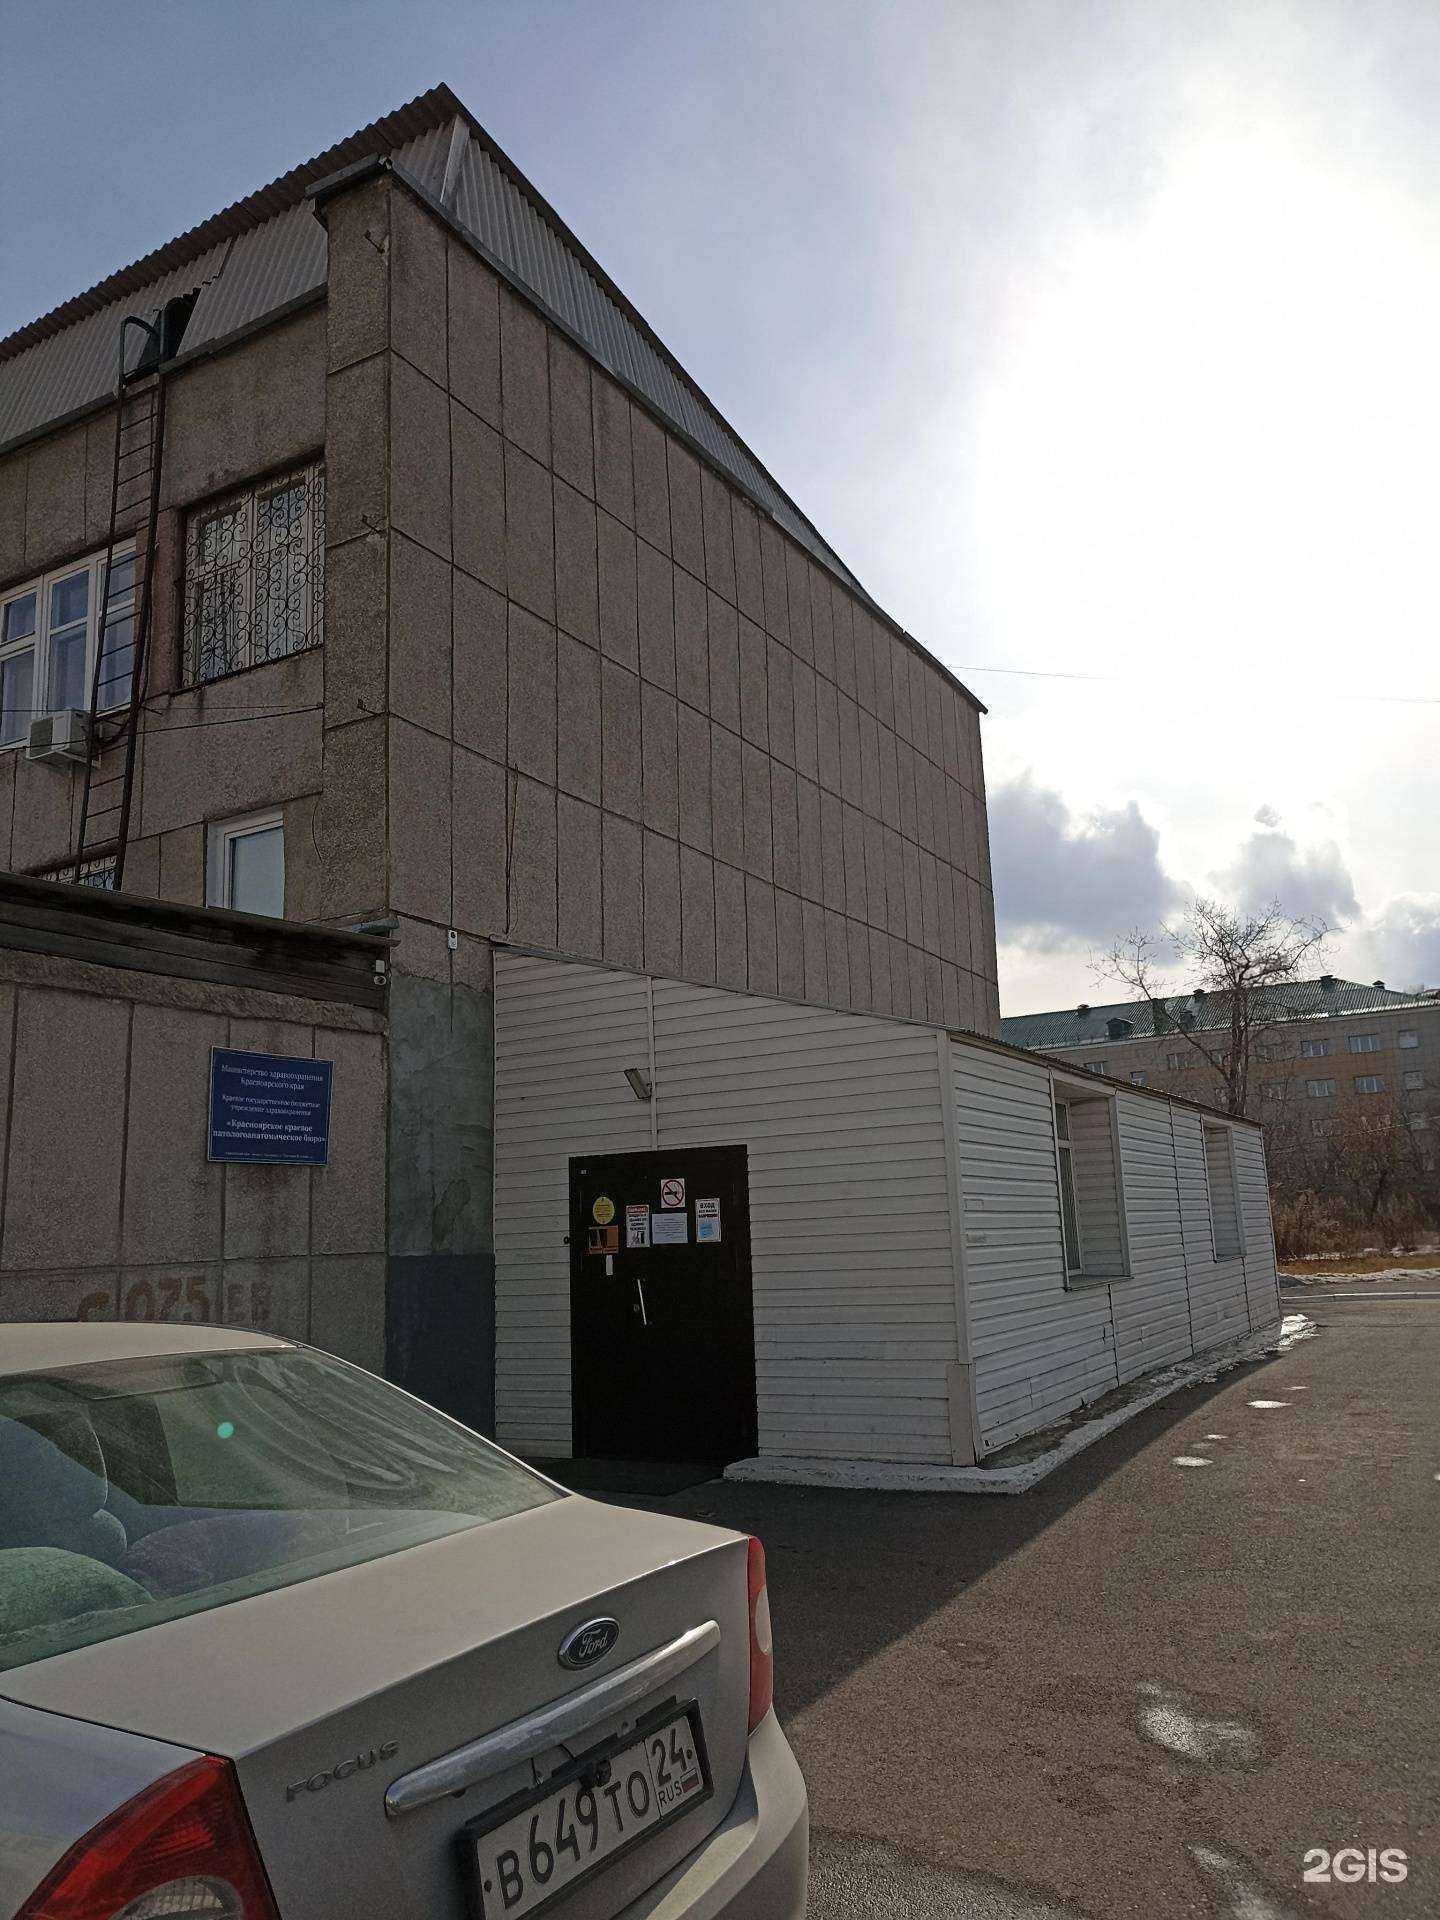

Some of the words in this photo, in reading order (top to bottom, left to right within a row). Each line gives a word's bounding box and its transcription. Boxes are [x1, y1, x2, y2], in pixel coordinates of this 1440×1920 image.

[221, 1064, 268, 1077] Министерство
[269, 1071, 324, 1082] здравоохранения
[240, 1077, 289, 1089] Красноярского
[213, 1129, 302, 1142] патологоанатомическое
[651, 1728, 688, 1787] 24
[285, 1738, 401, 1803] FOCUS
[658, 1780, 683, 1808] RUS
